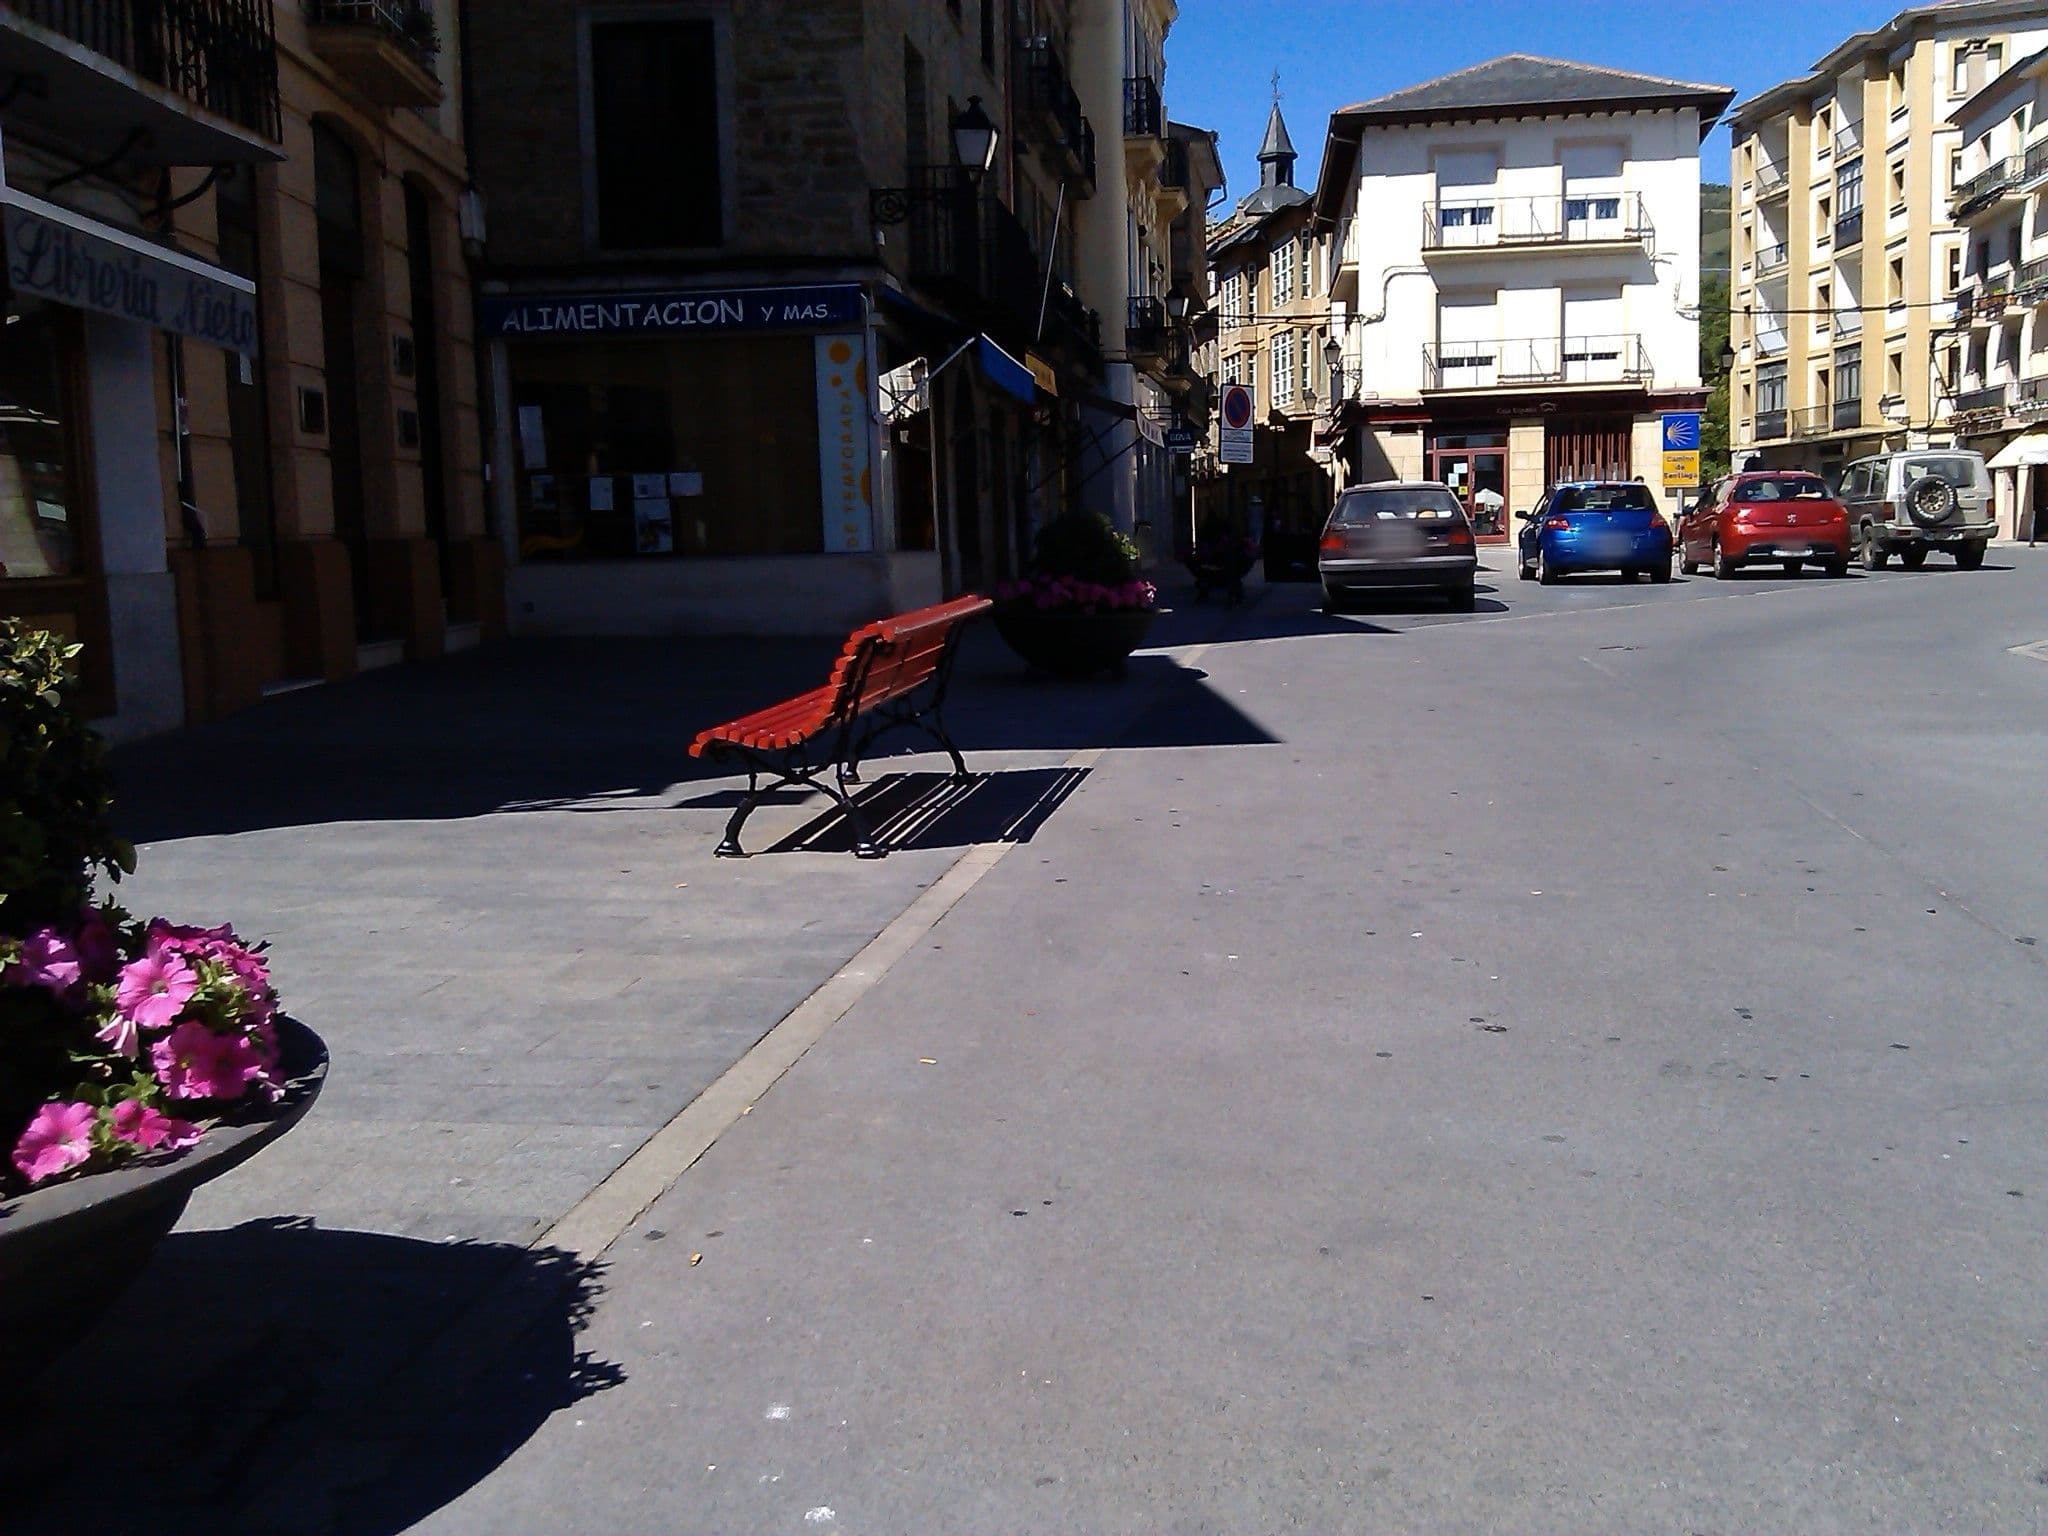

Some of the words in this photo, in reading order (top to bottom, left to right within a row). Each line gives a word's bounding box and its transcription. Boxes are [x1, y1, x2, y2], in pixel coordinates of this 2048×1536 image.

[175, 281, 253, 348] Nieto
[502, 297, 744, 332] ALIMENTACION
[1664, 472, 1697, 480] Santiago
